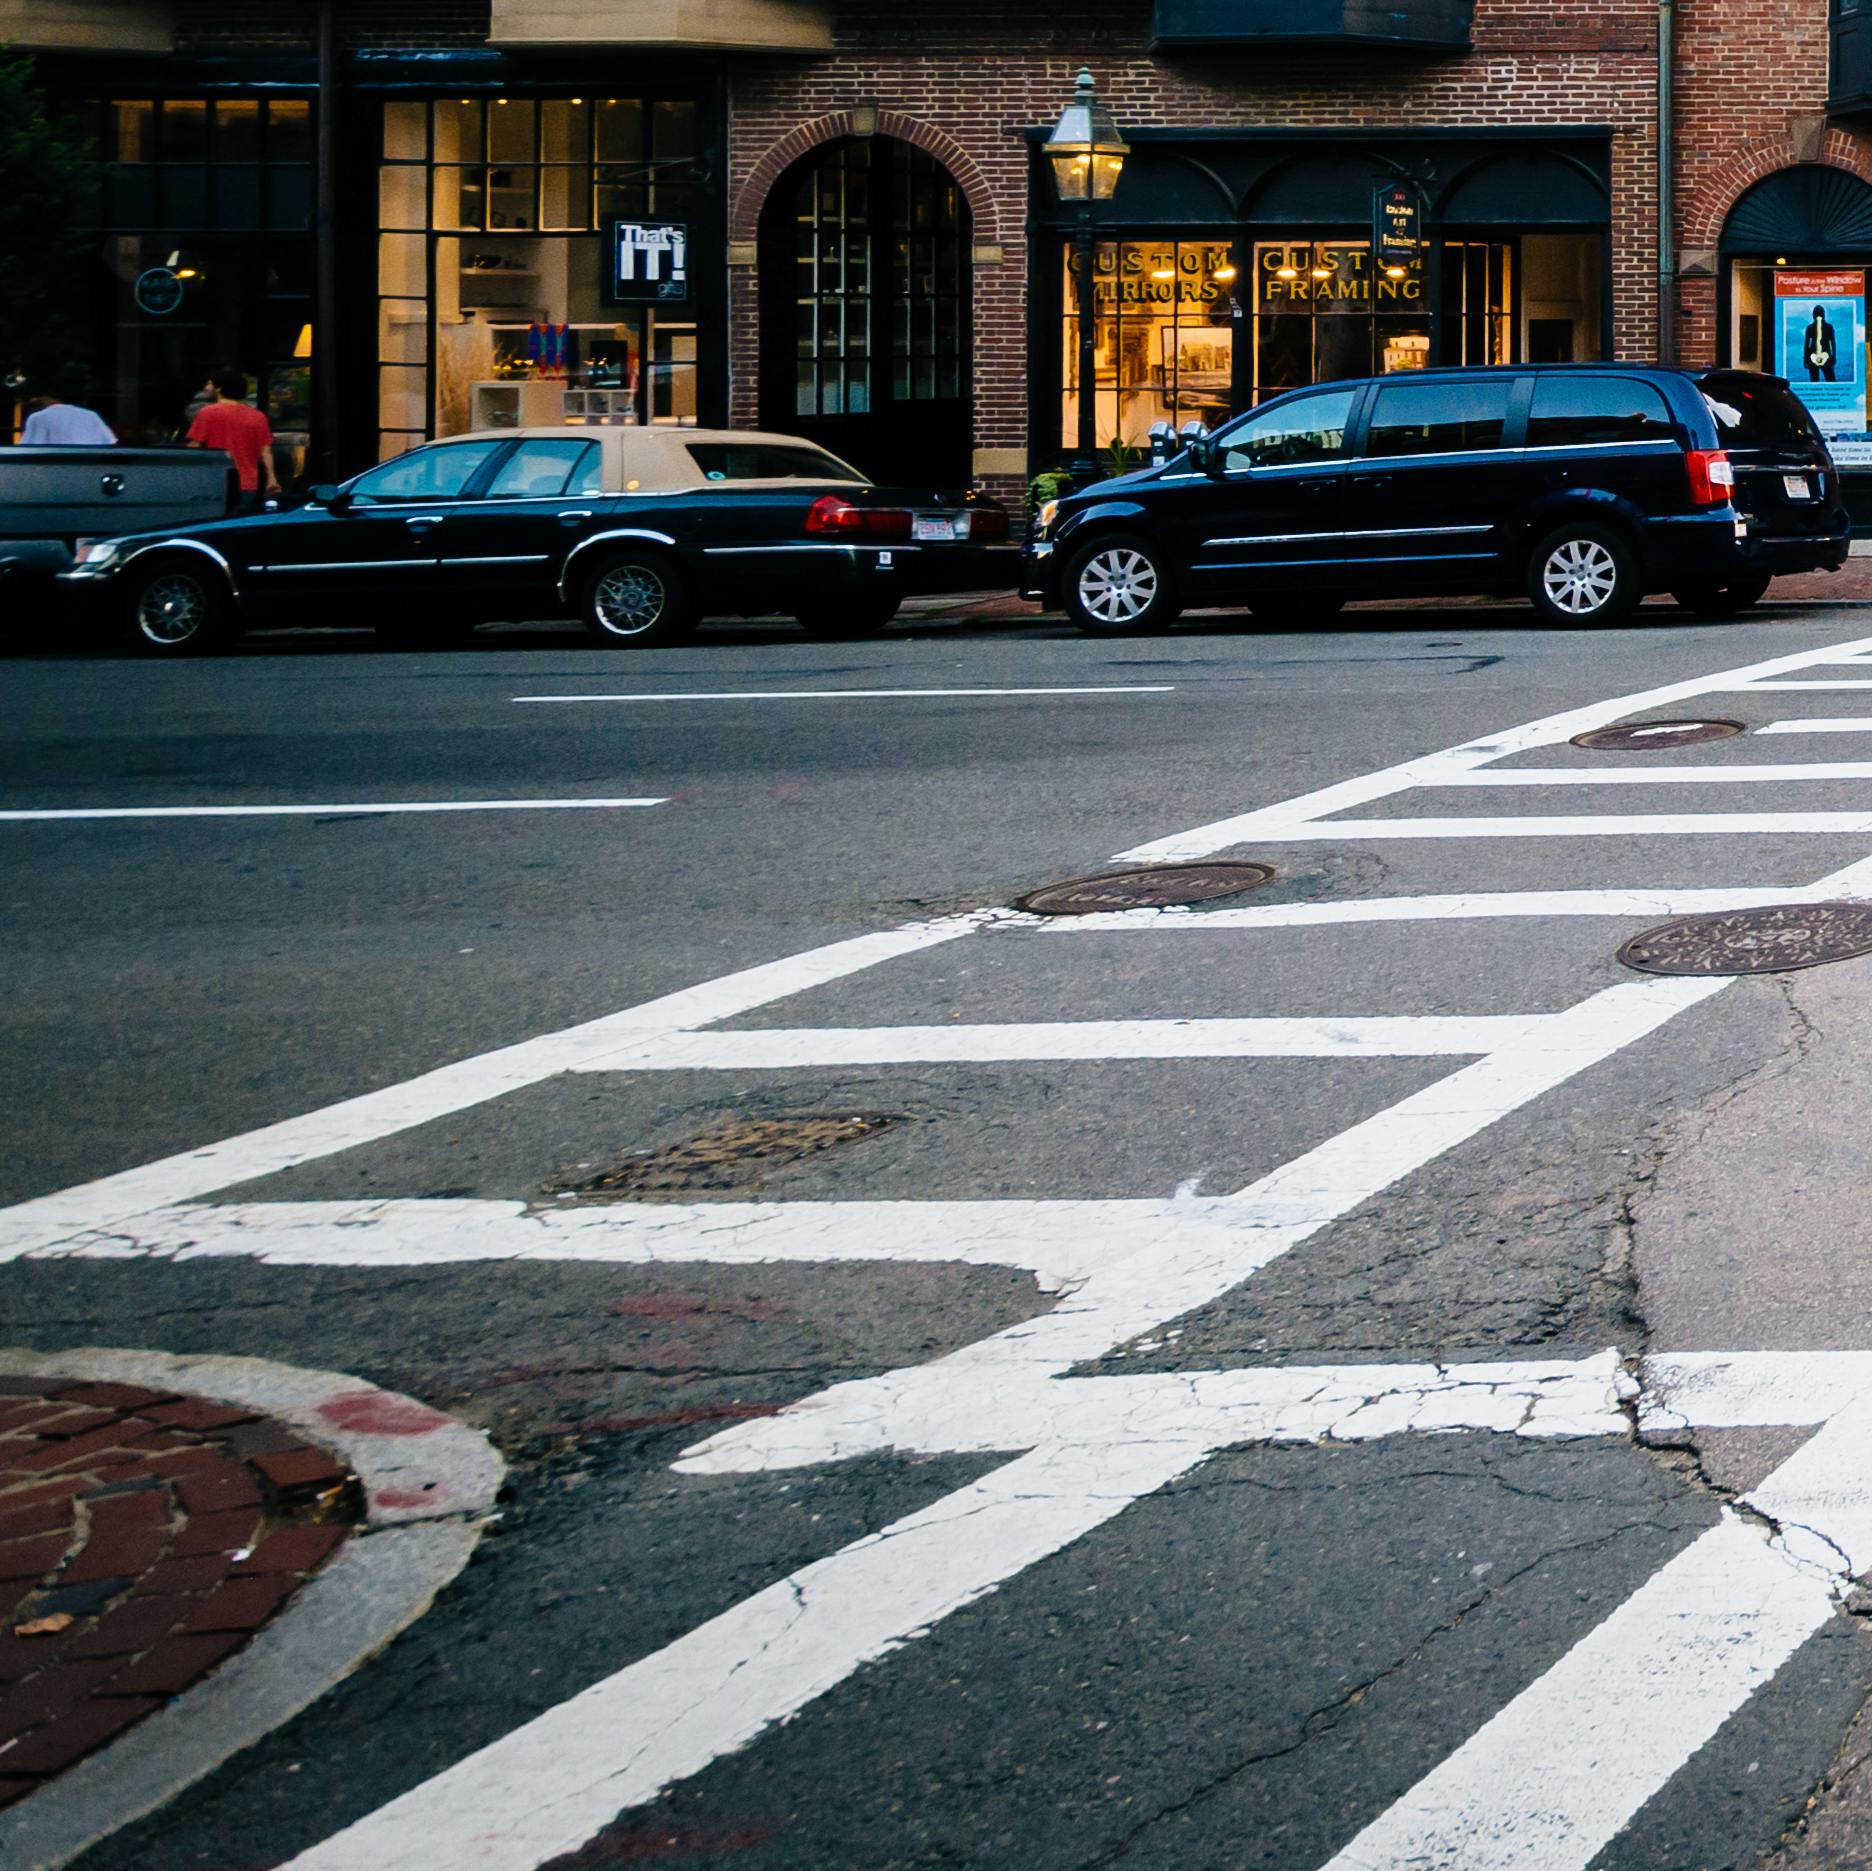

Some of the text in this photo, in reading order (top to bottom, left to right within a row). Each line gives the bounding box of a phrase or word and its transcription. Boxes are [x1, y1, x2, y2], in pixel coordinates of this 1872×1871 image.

[621, 224, 684, 244] That's
[621, 240, 685, 280] IT!
[1265, 280, 1421, 300] FRAMING
